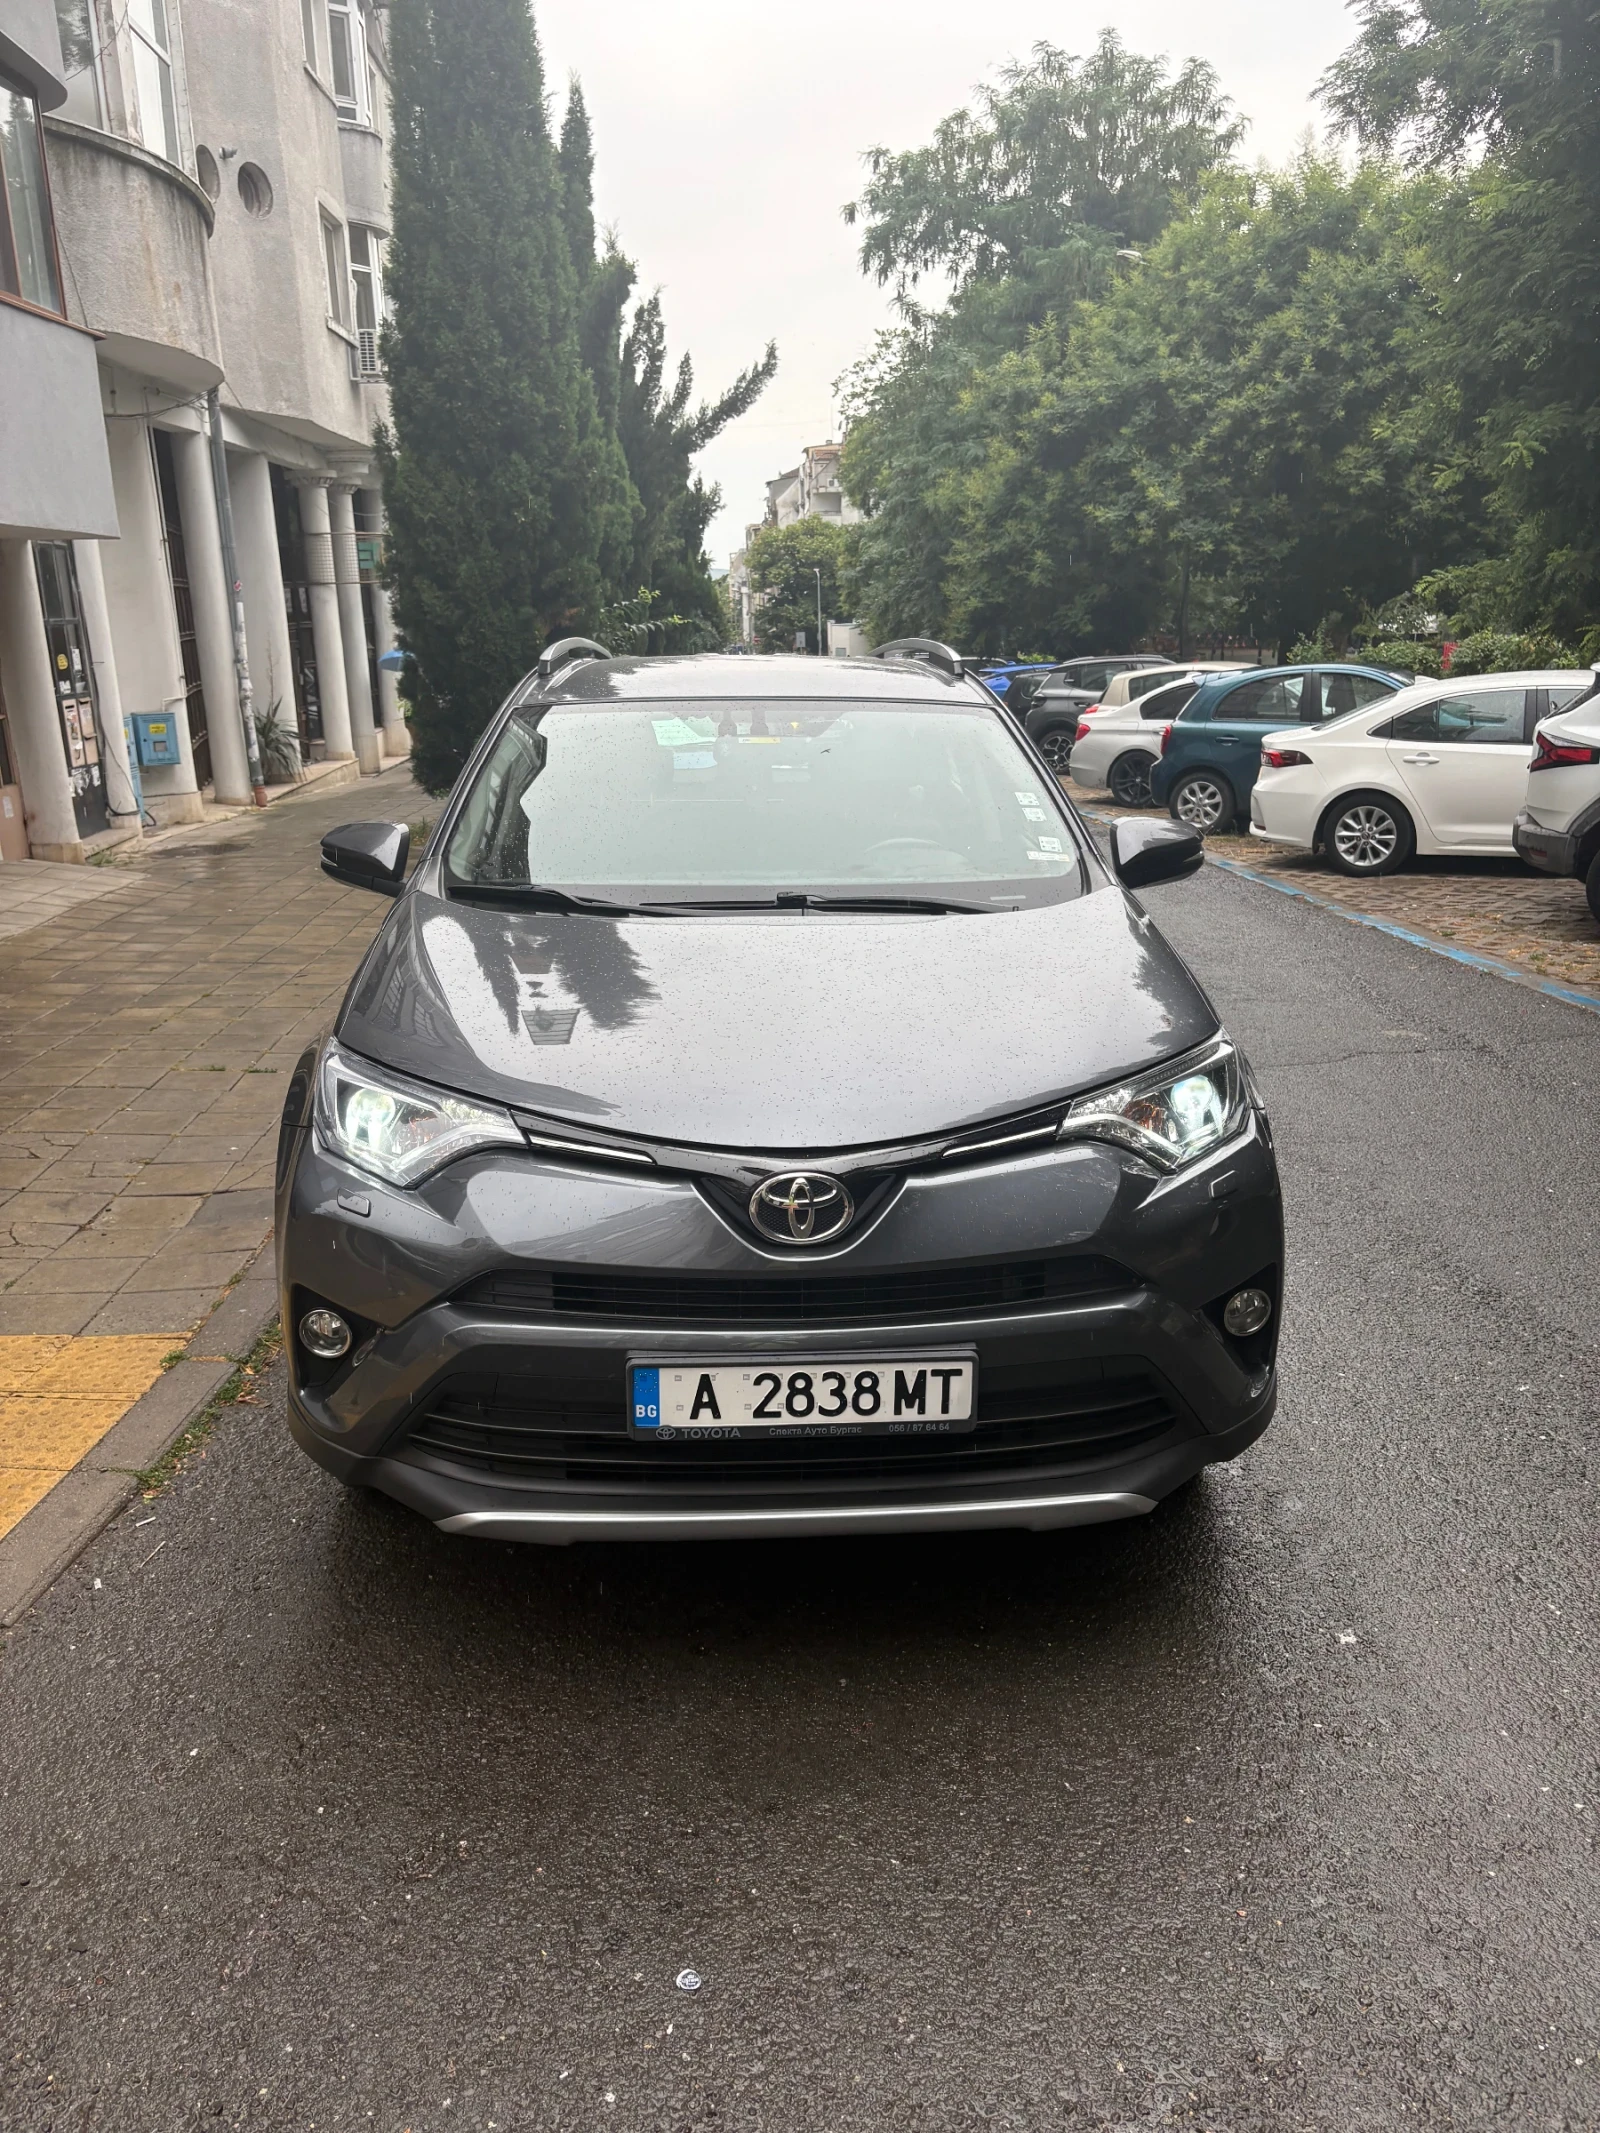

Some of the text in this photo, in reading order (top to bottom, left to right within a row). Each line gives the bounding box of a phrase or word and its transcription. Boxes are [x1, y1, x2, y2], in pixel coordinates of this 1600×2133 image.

[690, 1368, 963, 1420] A 2838 MT
[635, 1404, 658, 1418] BG
[681, 1427, 741, 1439] TOYOTA
[804, 1426, 828, 1436] Ауто
[830, 1425, 862, 1436] Бургас
[888, 1424, 905, 1433] 056
[912, 1423, 923, 1432] 87
[925, 1423, 937, 1431] 64
